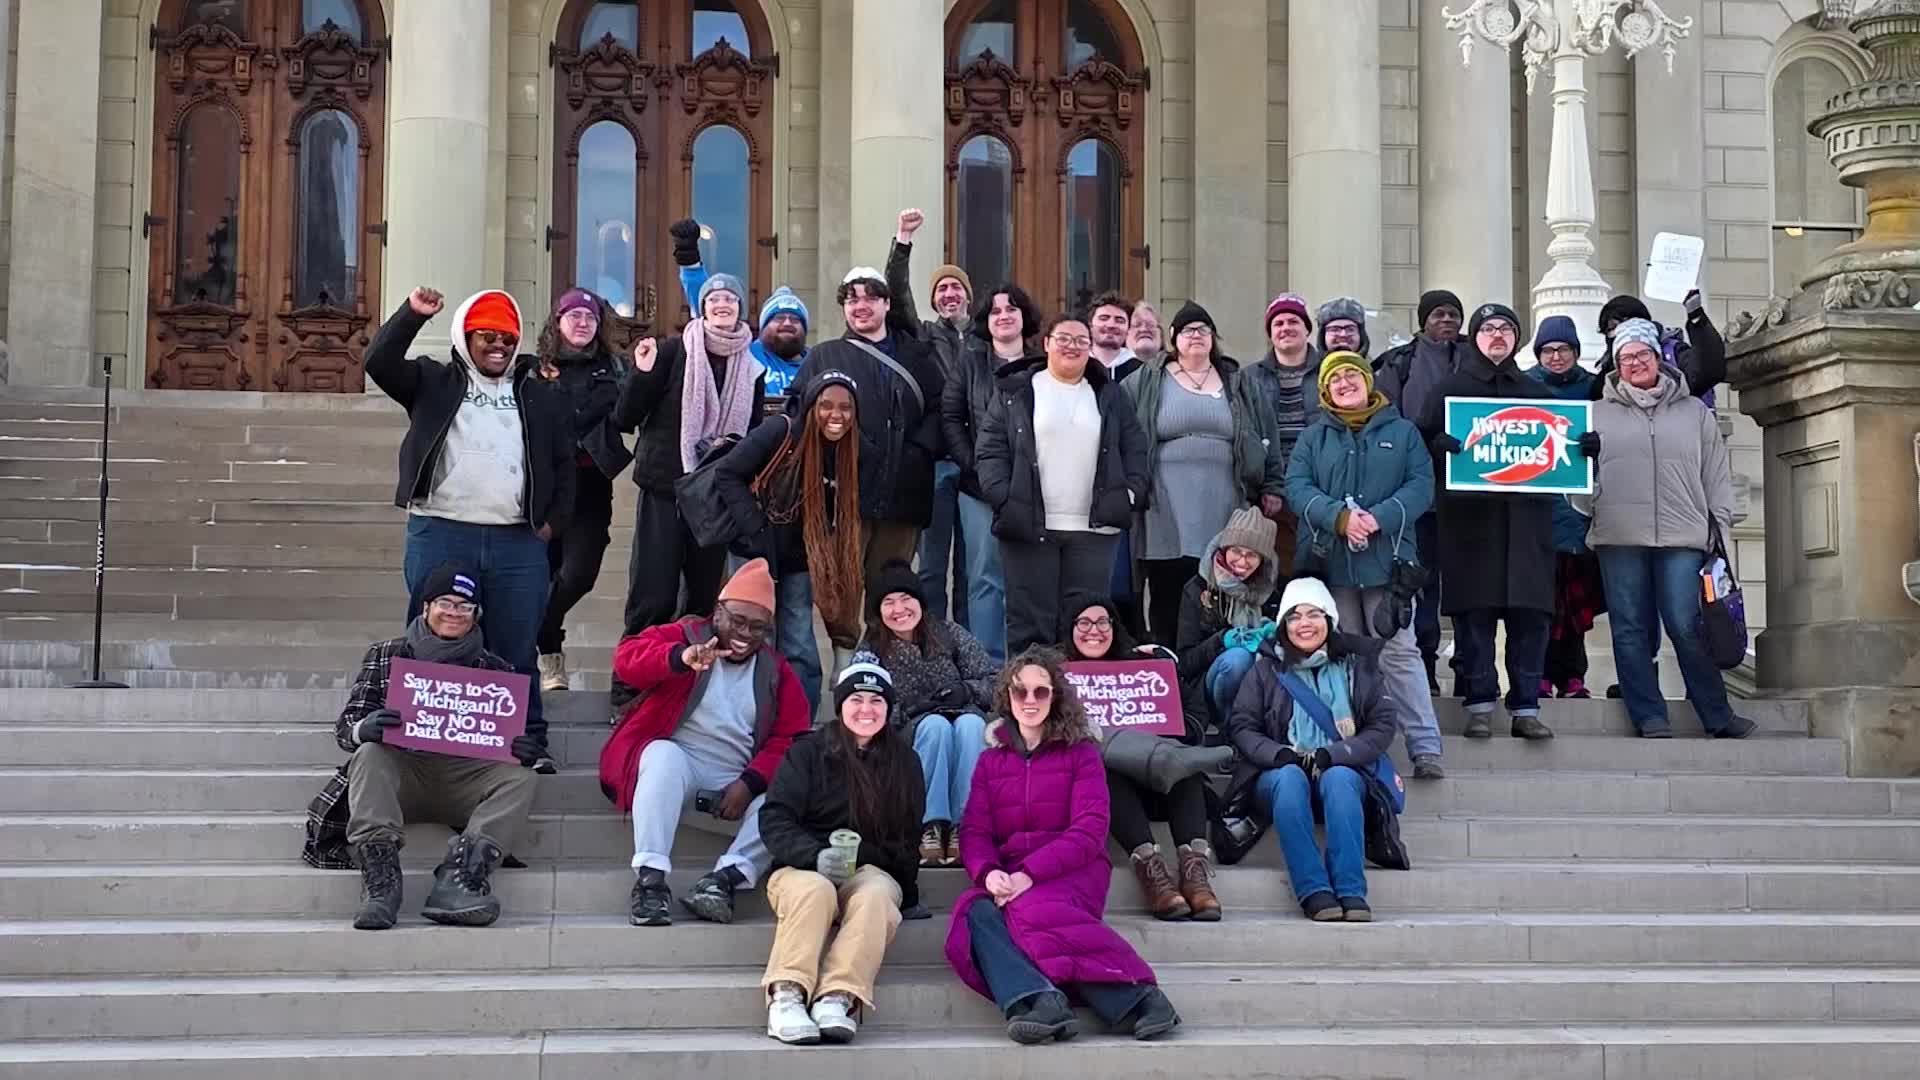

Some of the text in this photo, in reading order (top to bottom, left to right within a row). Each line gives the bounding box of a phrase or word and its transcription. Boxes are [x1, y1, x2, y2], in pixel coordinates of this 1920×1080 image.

[1472, 416, 1540, 435] INVEST
[1491, 432, 1507, 446] IN
[1473, 445, 1549, 465] MI KIDS
[404, 673, 483, 697] Say yes to
[1064, 672, 1135, 688] Say yes to
[1077, 684, 1150, 701] Michigan!
[412, 690, 495, 716] Michigan!
[1083, 701, 1156, 716] Say NO to
[416, 709, 497, 732] Say NO to
[1111, 712, 1168, 726] Centers
[404, 722, 505, 747] Data Centers
